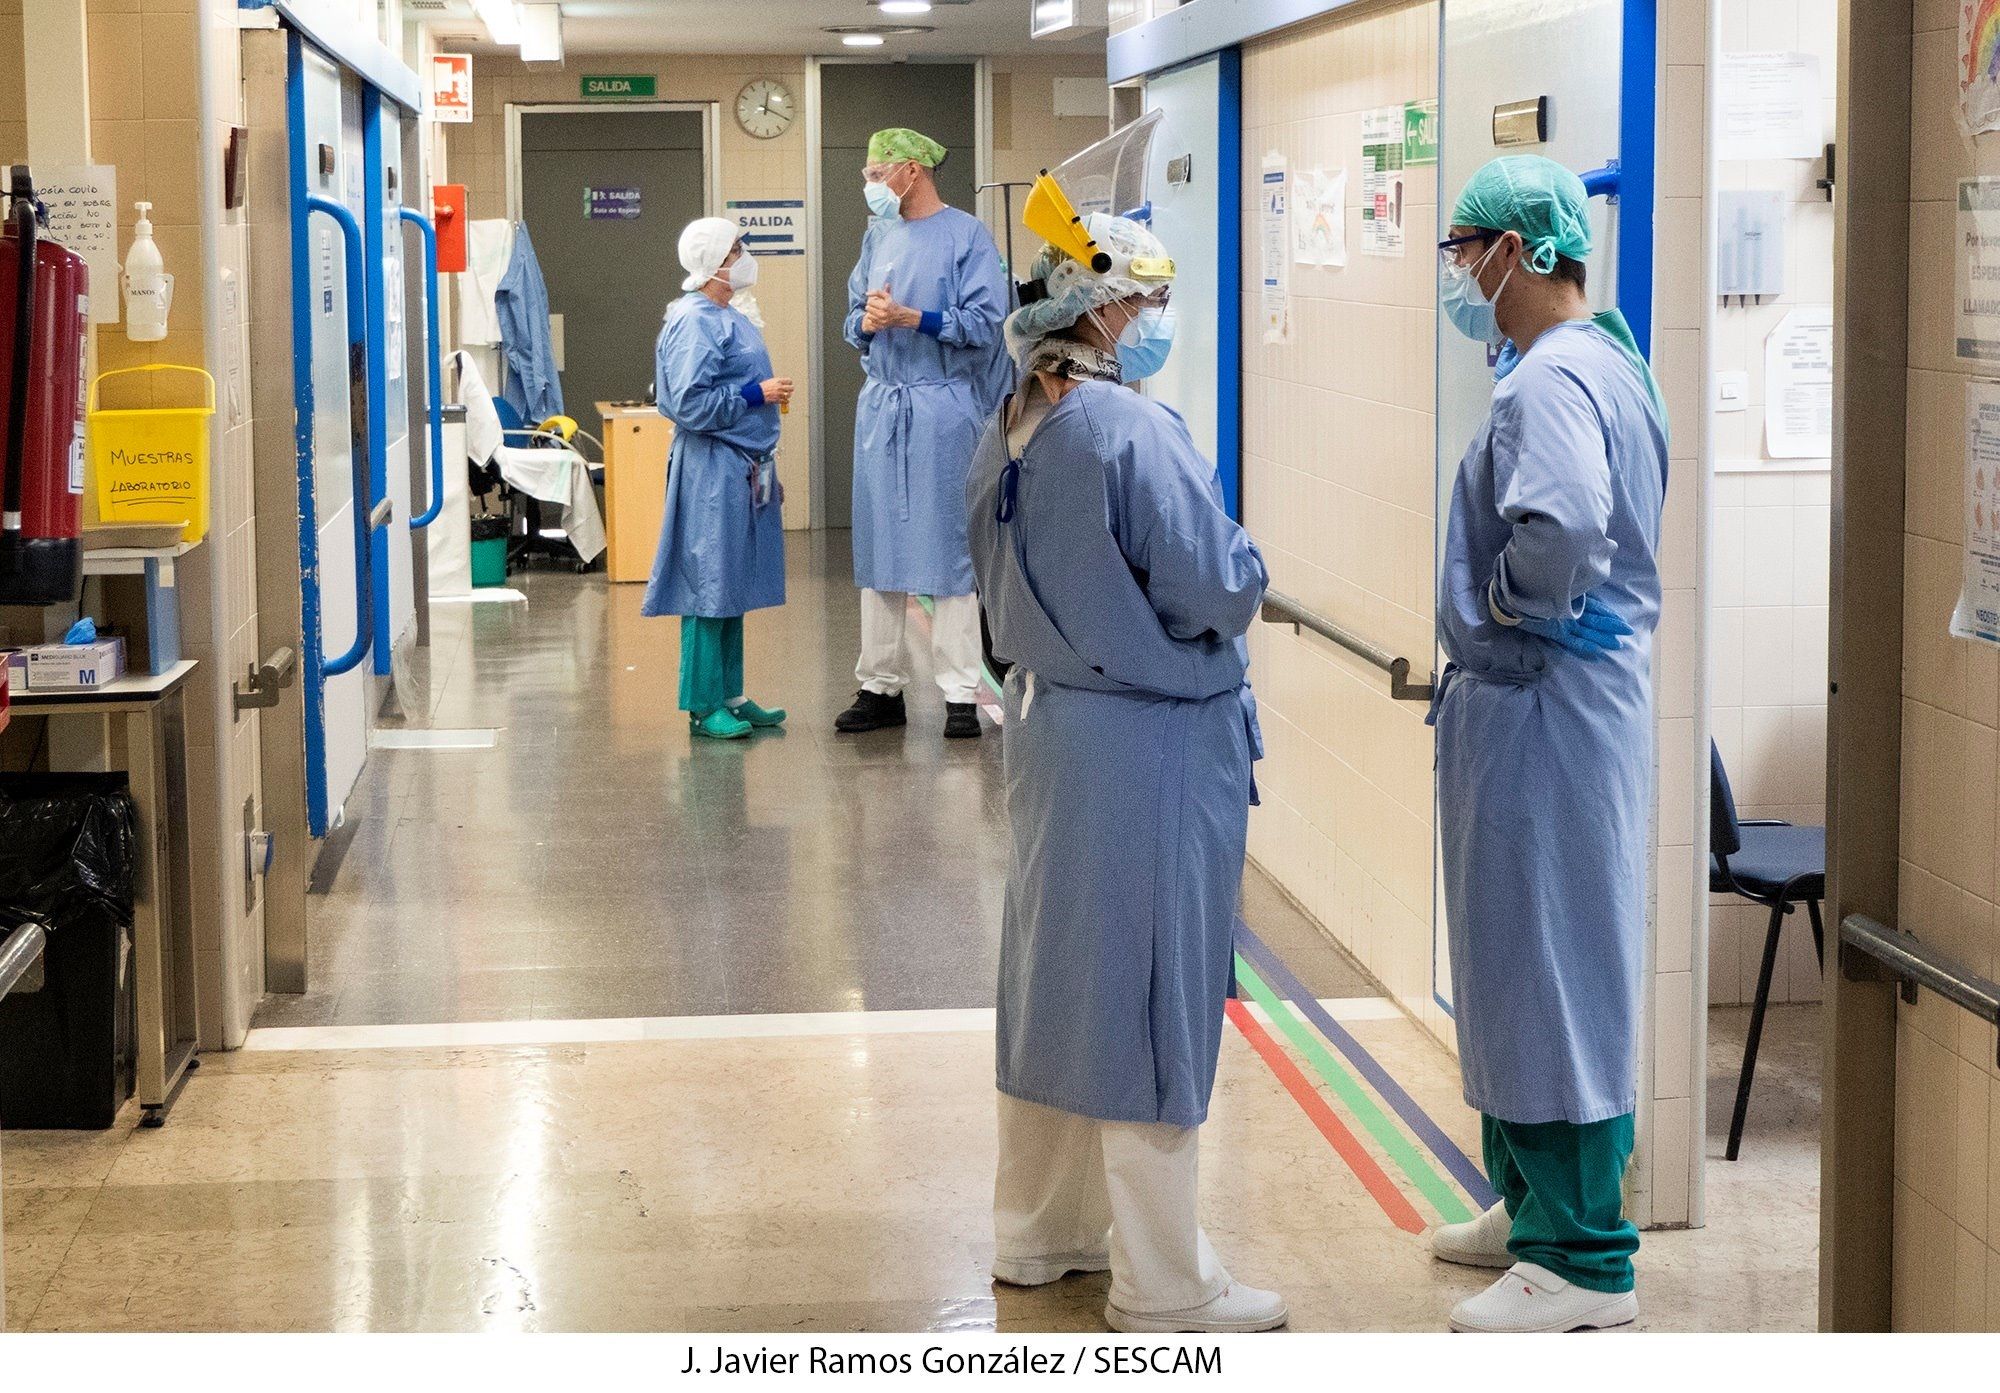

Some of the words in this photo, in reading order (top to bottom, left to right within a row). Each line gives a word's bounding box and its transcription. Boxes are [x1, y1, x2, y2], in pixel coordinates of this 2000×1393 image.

[589, 81, 632, 92] SALIDA
[609, 191, 641, 200] SALIDA
[739, 216, 794, 227] SALIDA
[111, 449, 194, 466] MUESTRAS
[110, 480, 191, 492] LABORATORIO
[79, 669, 95, 684] M
